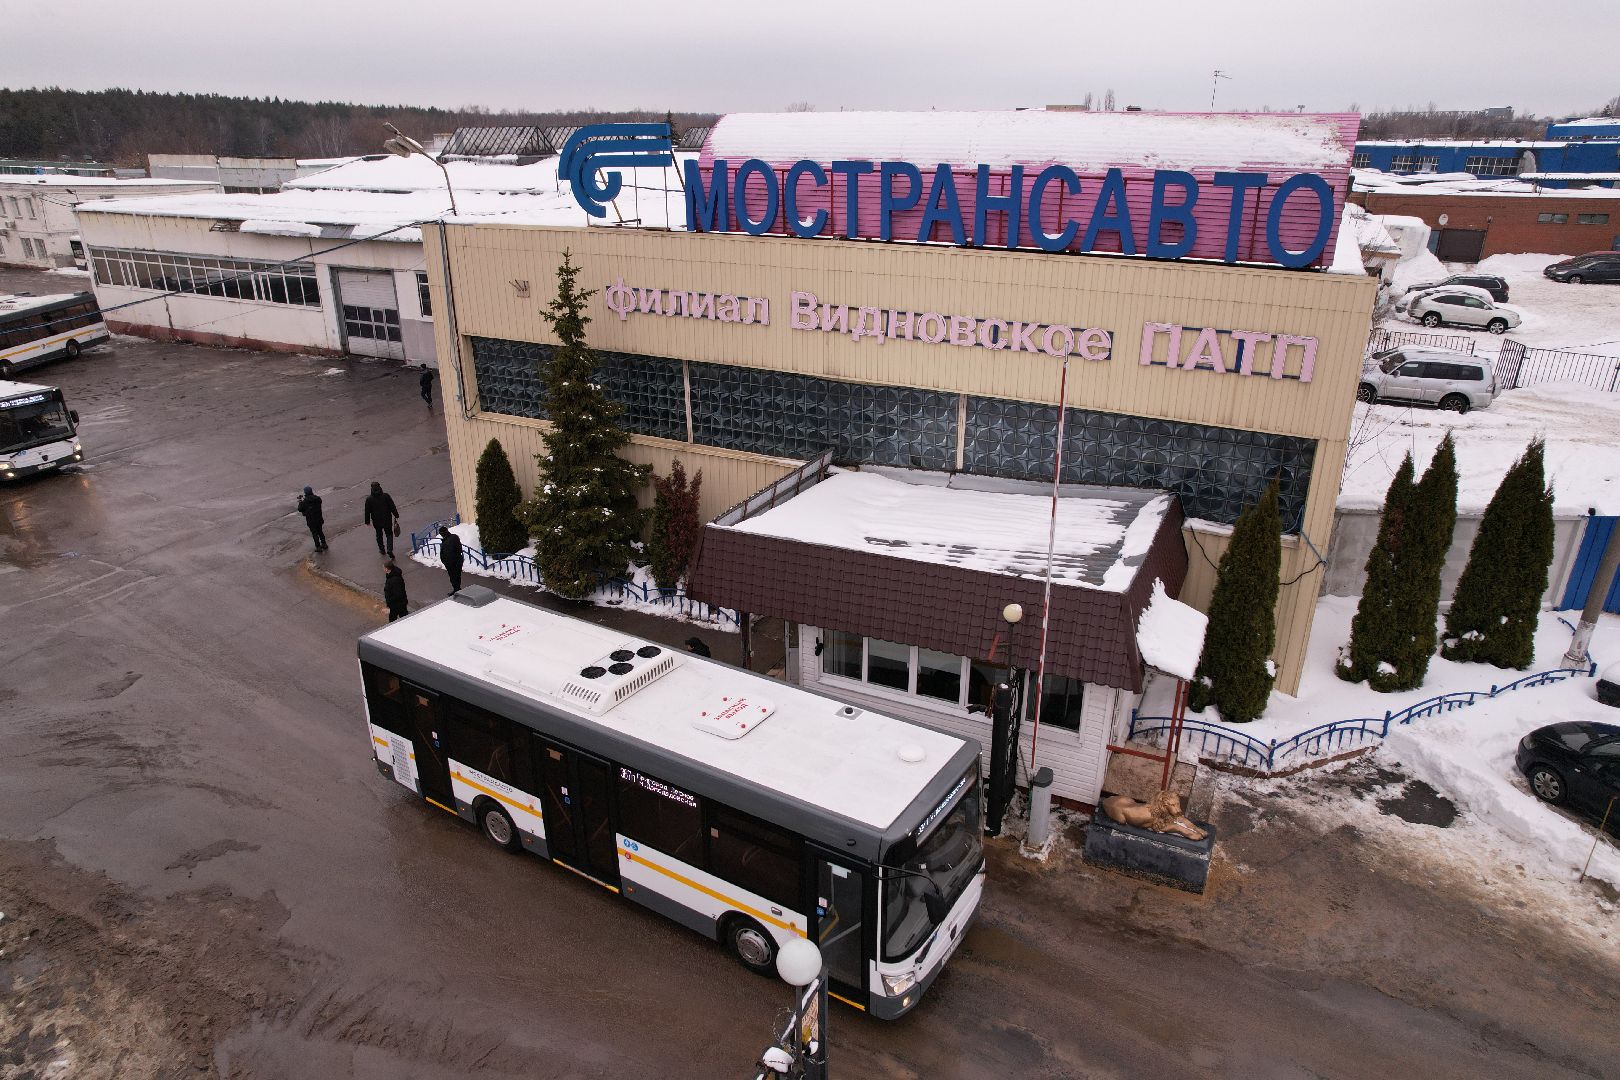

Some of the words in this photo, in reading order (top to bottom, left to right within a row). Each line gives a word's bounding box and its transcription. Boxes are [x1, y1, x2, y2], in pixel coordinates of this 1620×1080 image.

[683, 158, 1335, 269] МОСТРАНСАВТО
[790, 290, 1113, 362] Видновское
[1139, 321, 1319, 383] ПАТП
